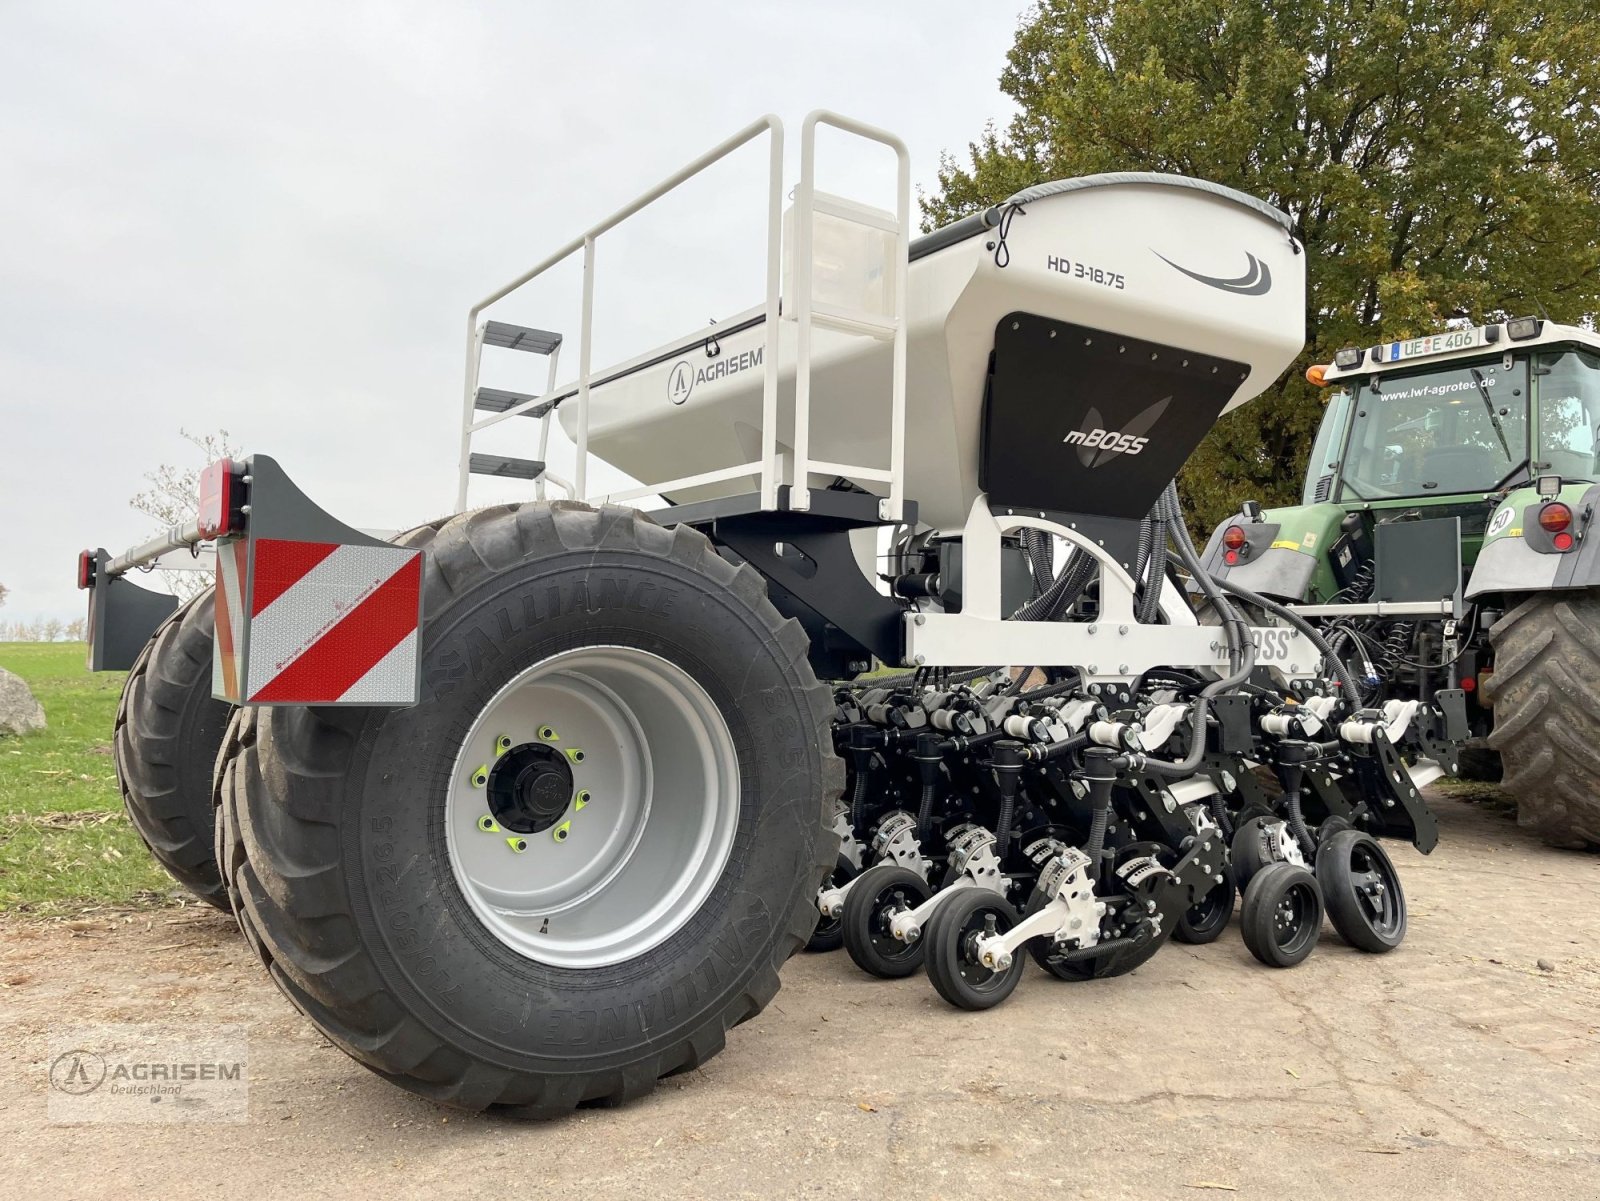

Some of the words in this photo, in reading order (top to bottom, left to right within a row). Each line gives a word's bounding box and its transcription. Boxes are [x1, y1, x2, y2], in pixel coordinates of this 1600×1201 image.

[1047, 254, 1071, 275] HD
[1074, 262, 1125, 290] 3-18.75
[1404, 341, 1423, 356] UE
[1432, 337, 1442, 351] E
[1445, 332, 1473, 348] 406
[695, 347, 763, 386] AGRISEM
[1380, 377, 1496, 402] www.lwf-agrotecde
[1063, 428, 1150, 455] mBOSS
[1490, 509, 1510, 534] 50
[465, 577, 679, 682] ALLIANCE
[1217, 629, 1290, 660] mOSS
[543, 920, 743, 1047] ALLIANCE
